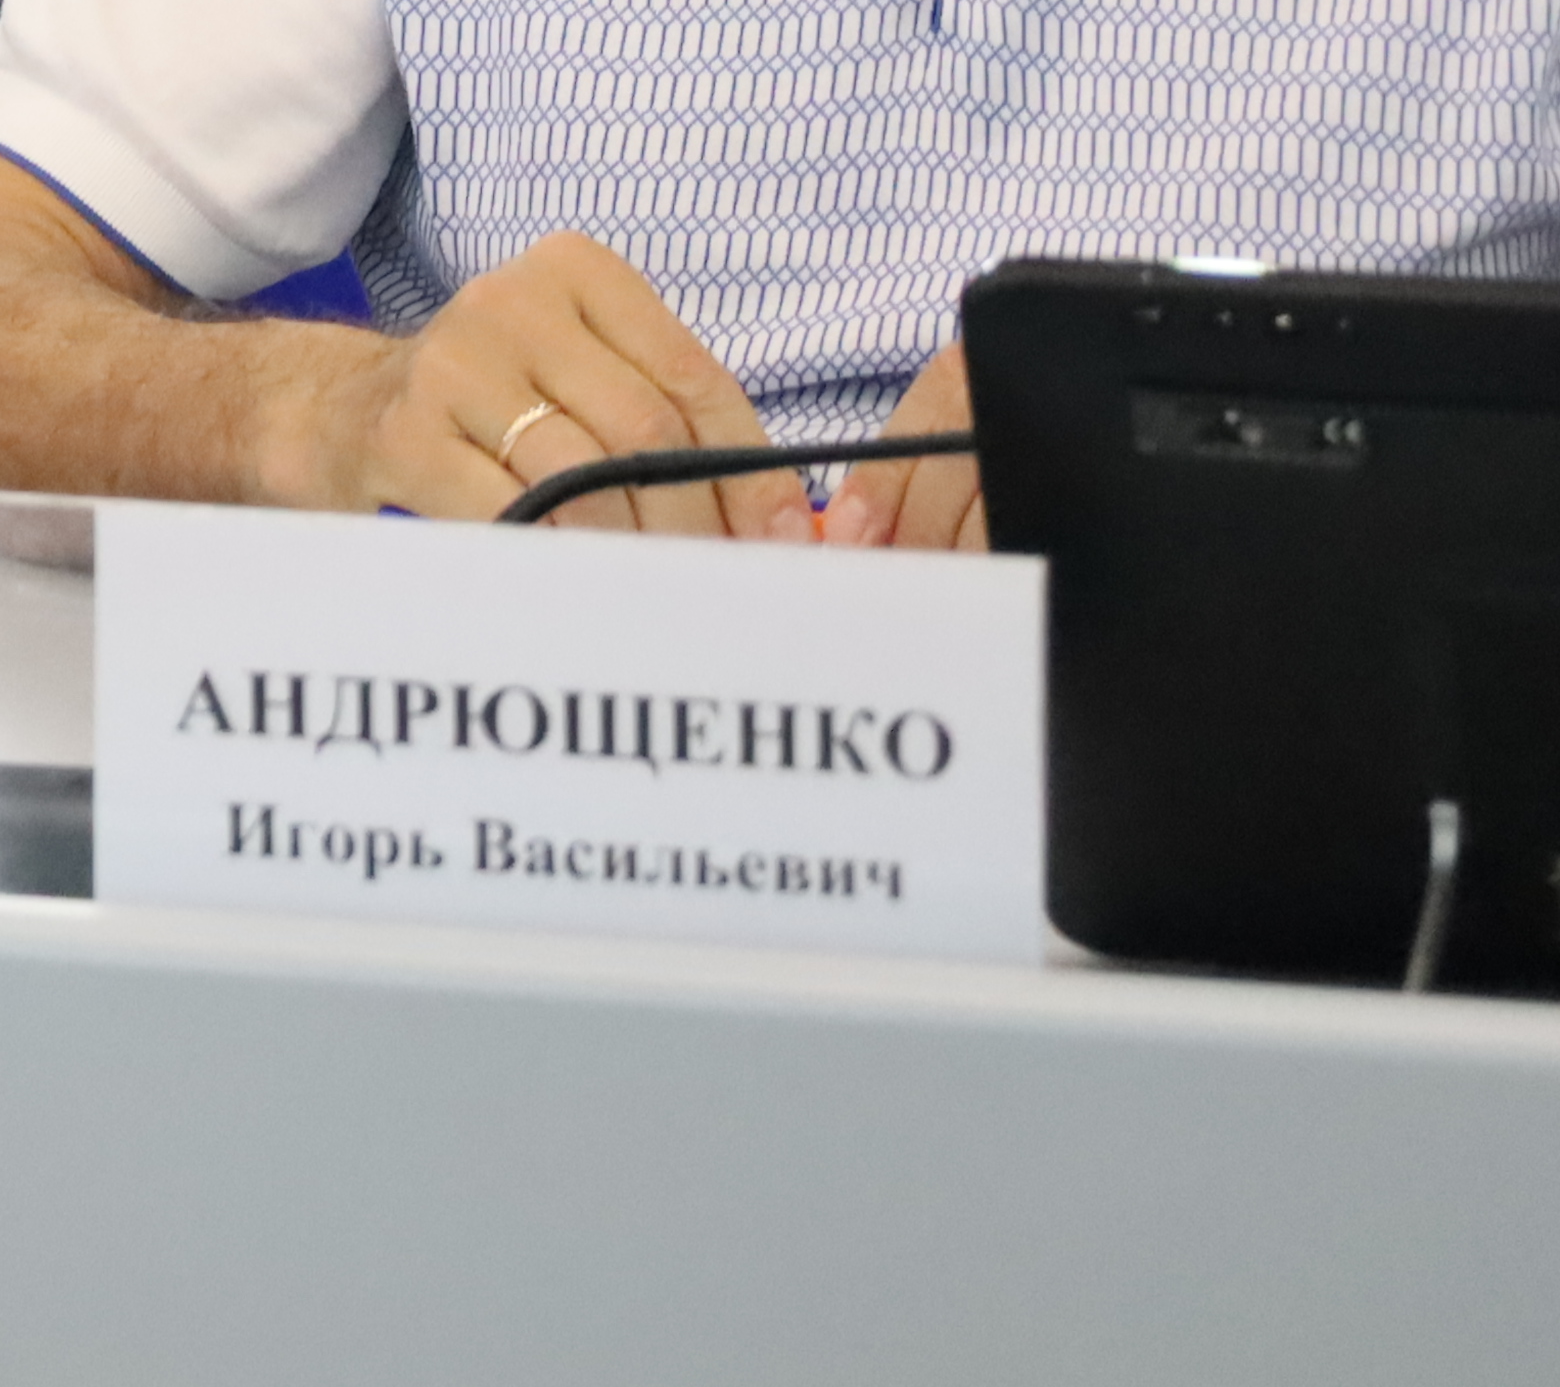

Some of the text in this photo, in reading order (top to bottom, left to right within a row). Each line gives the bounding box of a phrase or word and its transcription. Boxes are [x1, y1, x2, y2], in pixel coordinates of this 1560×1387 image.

[176, 668, 956, 782] АНДРЮЩЕНКО
[224, 802, 907, 902] Игорь Васильевич
